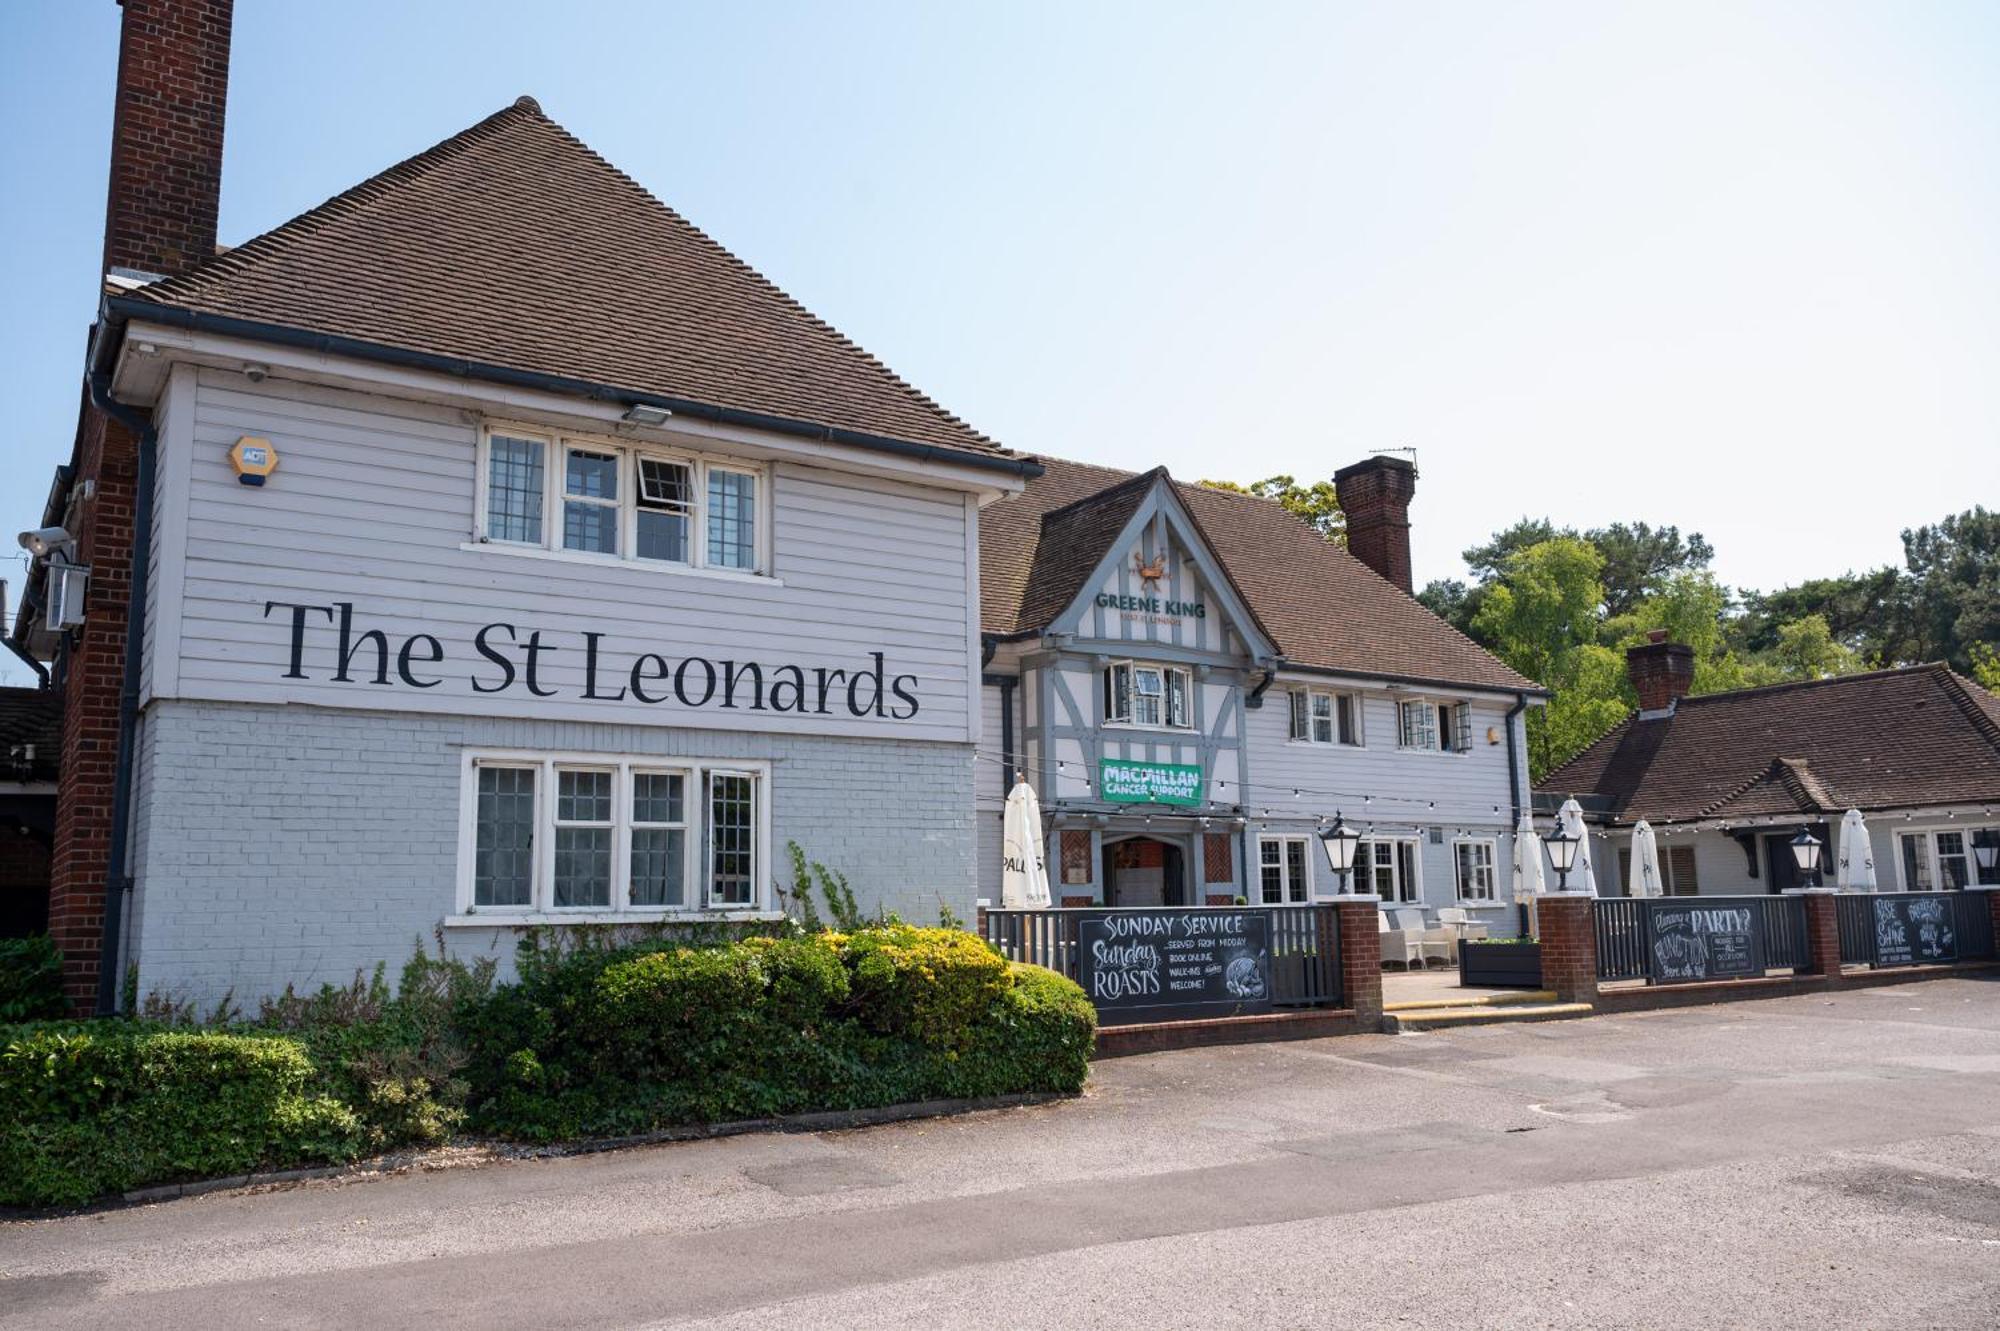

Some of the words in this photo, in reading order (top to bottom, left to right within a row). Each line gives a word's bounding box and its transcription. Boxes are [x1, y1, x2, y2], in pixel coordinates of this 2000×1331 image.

[1096, 592, 1160, 614] GREENE
[1165, 600, 1206, 618] KING
[264, 600, 444, 689] The
[470, 622, 559, 697] St
[579, 630, 920, 720] Leonards
[1104, 765, 1199, 787] MACMILLAN
[1105, 783, 1148, 794] CANCER
[1150, 784, 1194, 798] SUPPORT
[1104, 915, 1174, 941] SUNDAY
[1182, 914, 1244, 937] SERVICE
[1691, 908, 1750, 934] PARTY?
[1092, 938, 1161, 970] Sunday
[1198, 938, 1216, 948] FROM
[1219, 937, 1246, 947] MIDDAY
[1094, 969, 1160, 1000] ROASTS
[1170, 979, 1205, 991] WELCOME!
